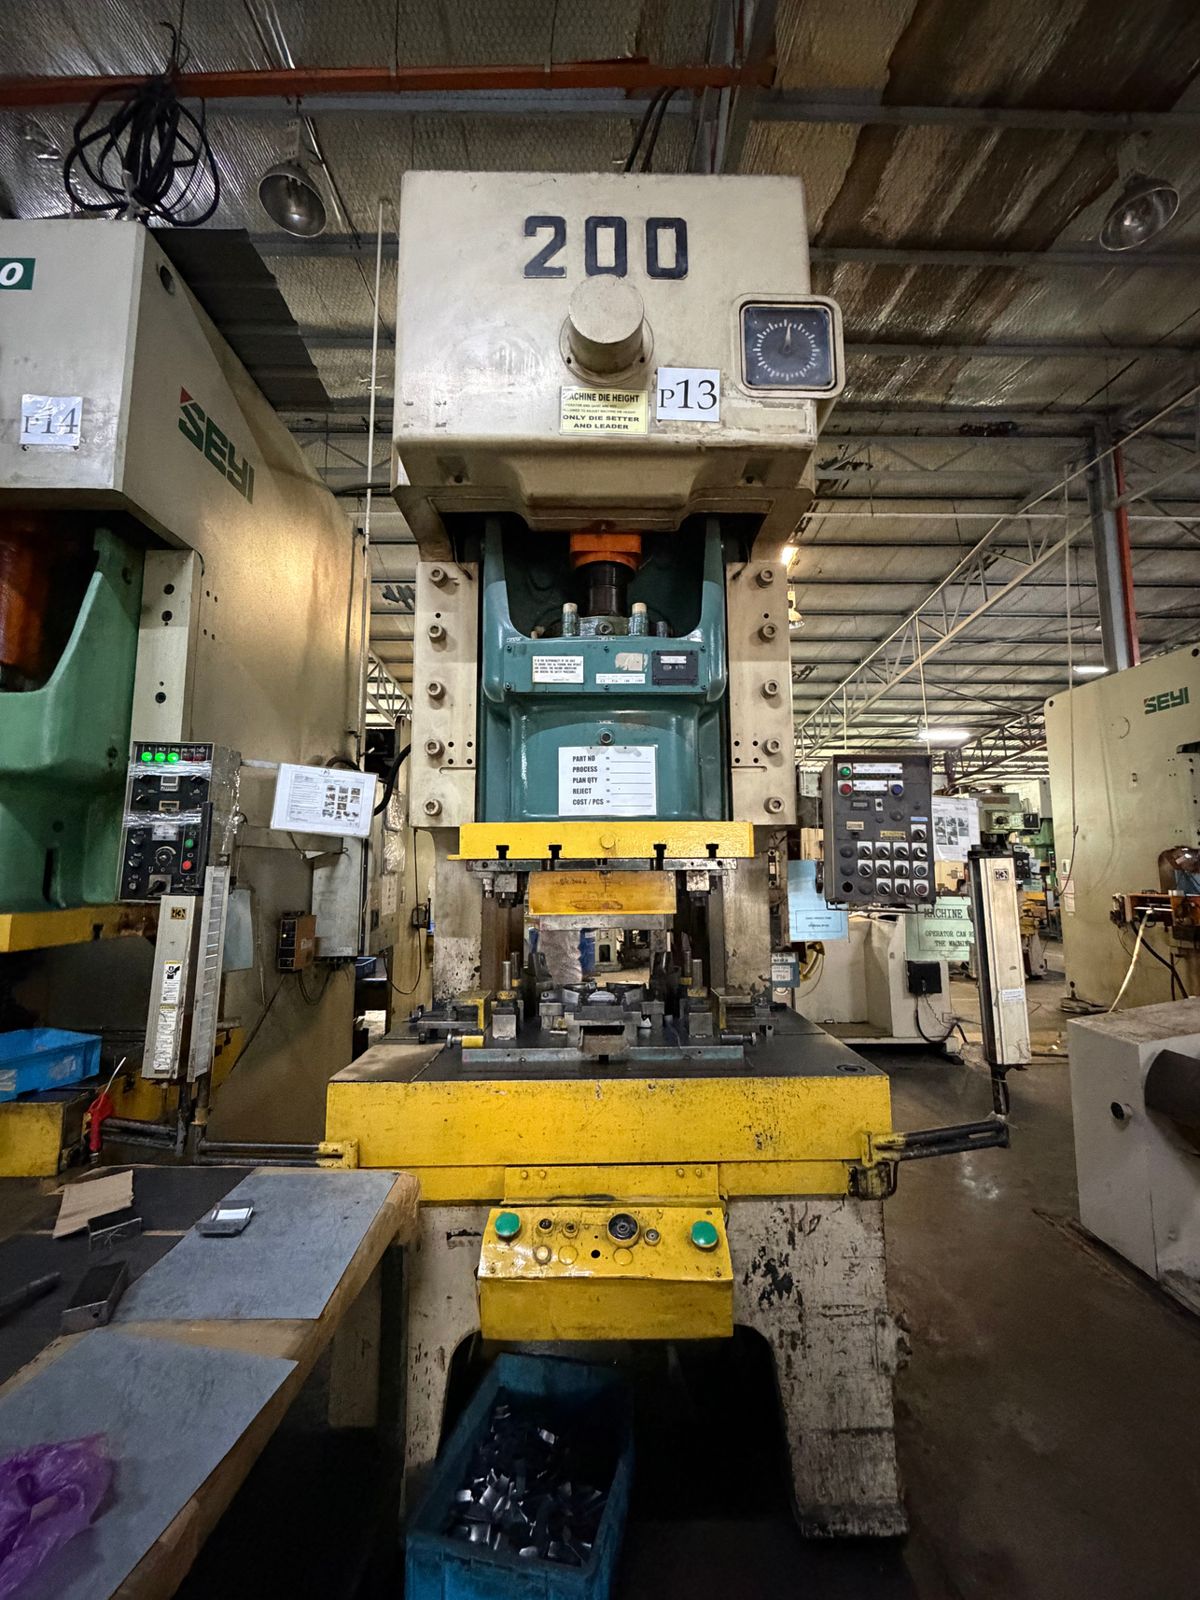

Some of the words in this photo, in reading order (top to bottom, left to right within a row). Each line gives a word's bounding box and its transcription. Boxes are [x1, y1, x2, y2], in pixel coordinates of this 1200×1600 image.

[524, 215, 688, 279] 200
[563, 392, 596, 402] ACHINE
[598, 393, 610, 402] DIE
[612, 394, 640, 403] HEIGHT
[658, 379, 718, 410] P13
[178, 386, 255, 505] SEYI
[1144, 686, 1190, 715] SEYI
[924, 908, 963, 918] MACHINE
